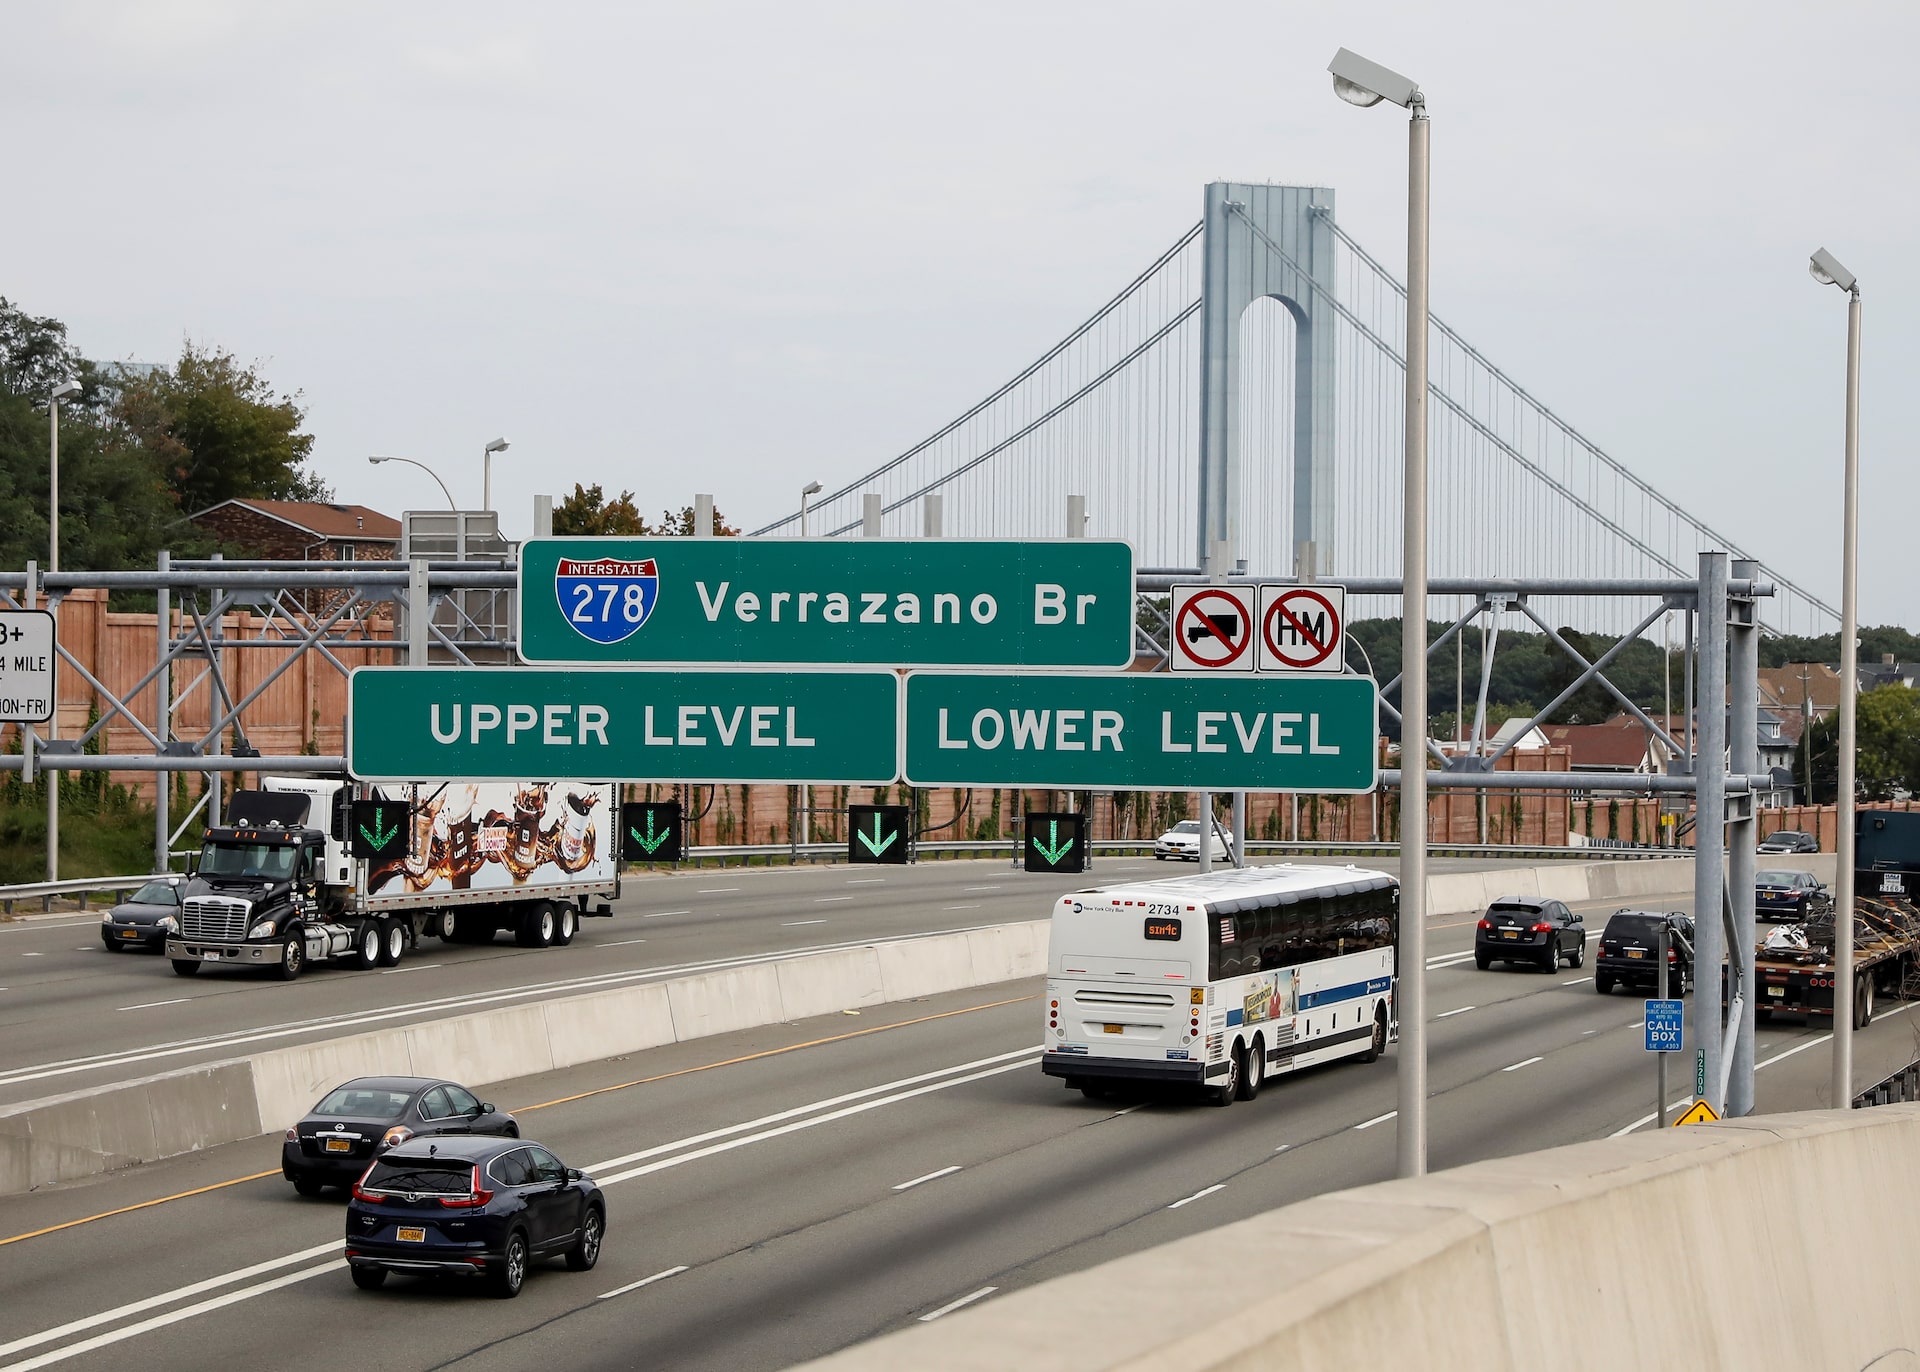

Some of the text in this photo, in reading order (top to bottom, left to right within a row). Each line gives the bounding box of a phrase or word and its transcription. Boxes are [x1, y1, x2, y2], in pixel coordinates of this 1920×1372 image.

[568, 563, 646, 576] INTERSTATE
[572, 583, 644, 623] 278
[695, 581, 1097, 625] Verrazano Br
[1277, 611, 1325, 646] HM
[15, 656, 47, 672] MILE
[0, 699, 46, 714] ON-FRI
[430, 703, 816, 747] UPPER LEVEL
[938, 708, 1340, 755] LOWER LEVEL
[1148, 904, 1180, 916] 2734
[1647, 1020, 1681, 1031] CALL
[1651, 1031, 1676, 1042] BOX
